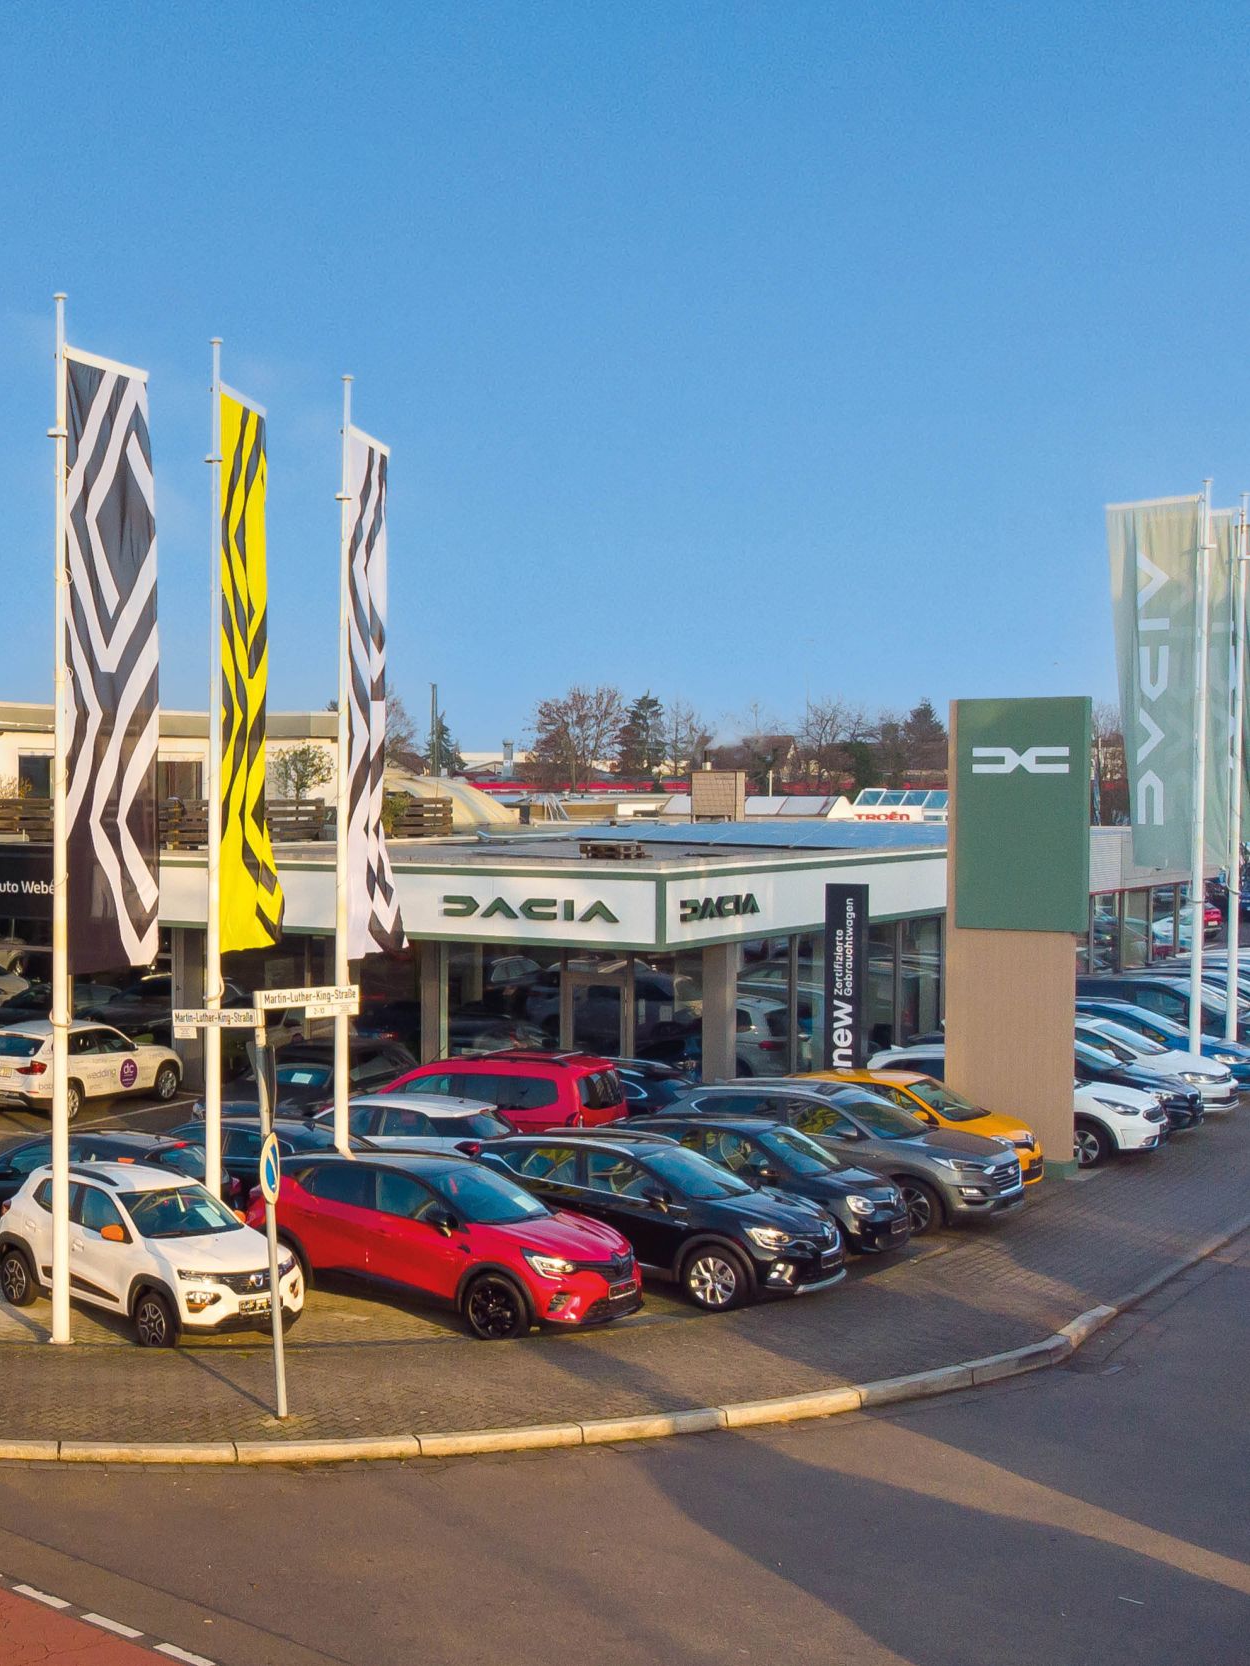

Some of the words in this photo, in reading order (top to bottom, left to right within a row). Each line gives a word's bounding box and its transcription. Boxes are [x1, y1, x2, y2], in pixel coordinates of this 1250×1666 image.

[854, 811, 911, 821] TROËN
[20, 880, 54, 895] Webe
[442, 894, 620, 923] DACIA
[679, 892, 761, 923] DACIA
[843, 897, 856, 997] Gebrauchtwagen
[833, 928, 844, 996] Zertifizierte
[264, 990, 356, 1005] Martin-Luther-King-Straße
[174, 1011, 254, 1025] Martin-Luther-King-Straße
[832, 999, 854, 1068] new
